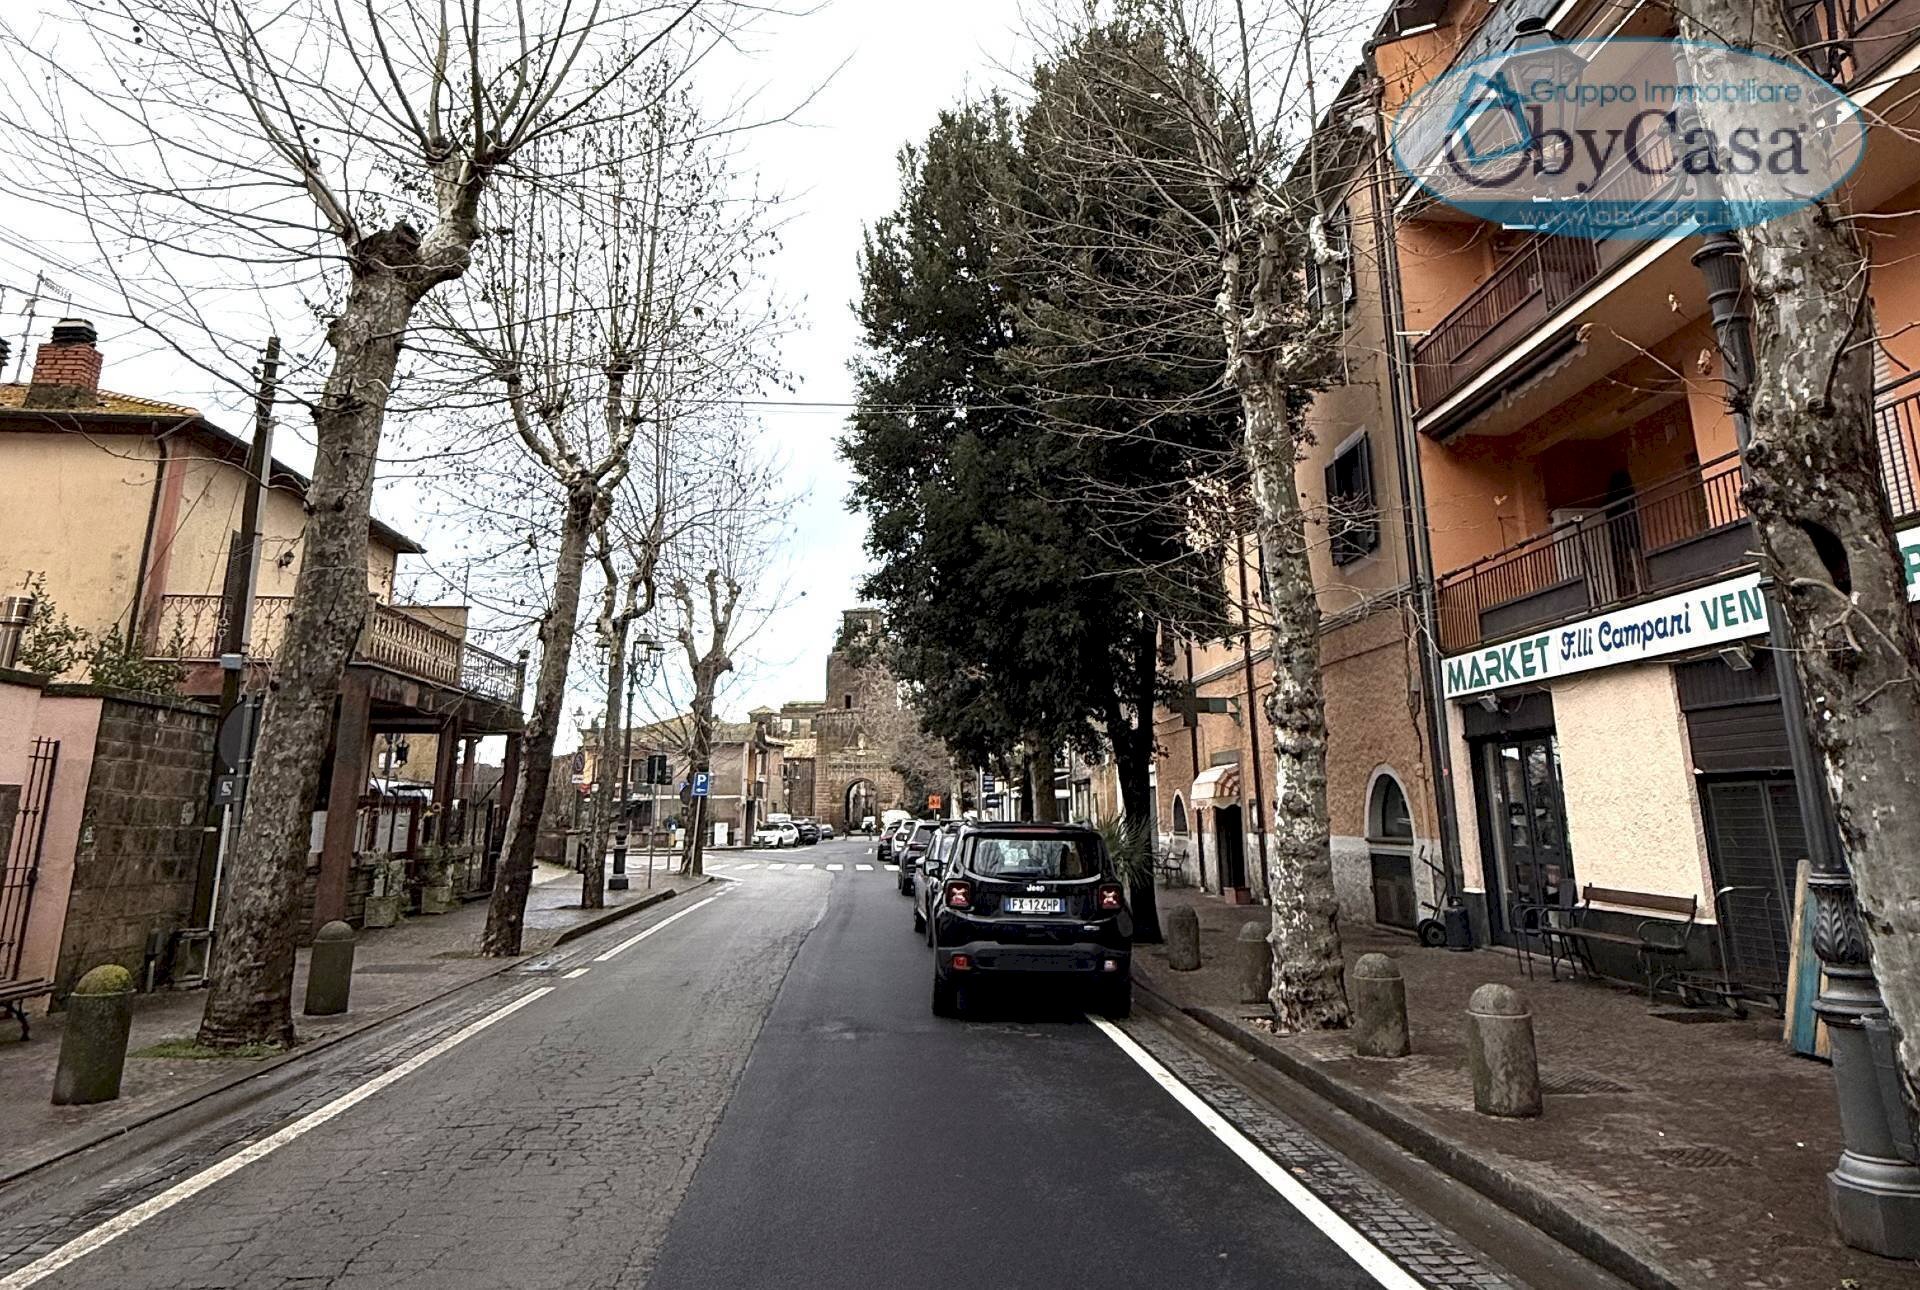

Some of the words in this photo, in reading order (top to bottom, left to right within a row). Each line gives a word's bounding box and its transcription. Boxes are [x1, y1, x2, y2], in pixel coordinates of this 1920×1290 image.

[1448, 636, 1550, 693] MARKET
[1561, 628, 1593, 661] F.lli
[697, 774, 707, 786] P
[1026, 884, 1045, 893] Jeep
